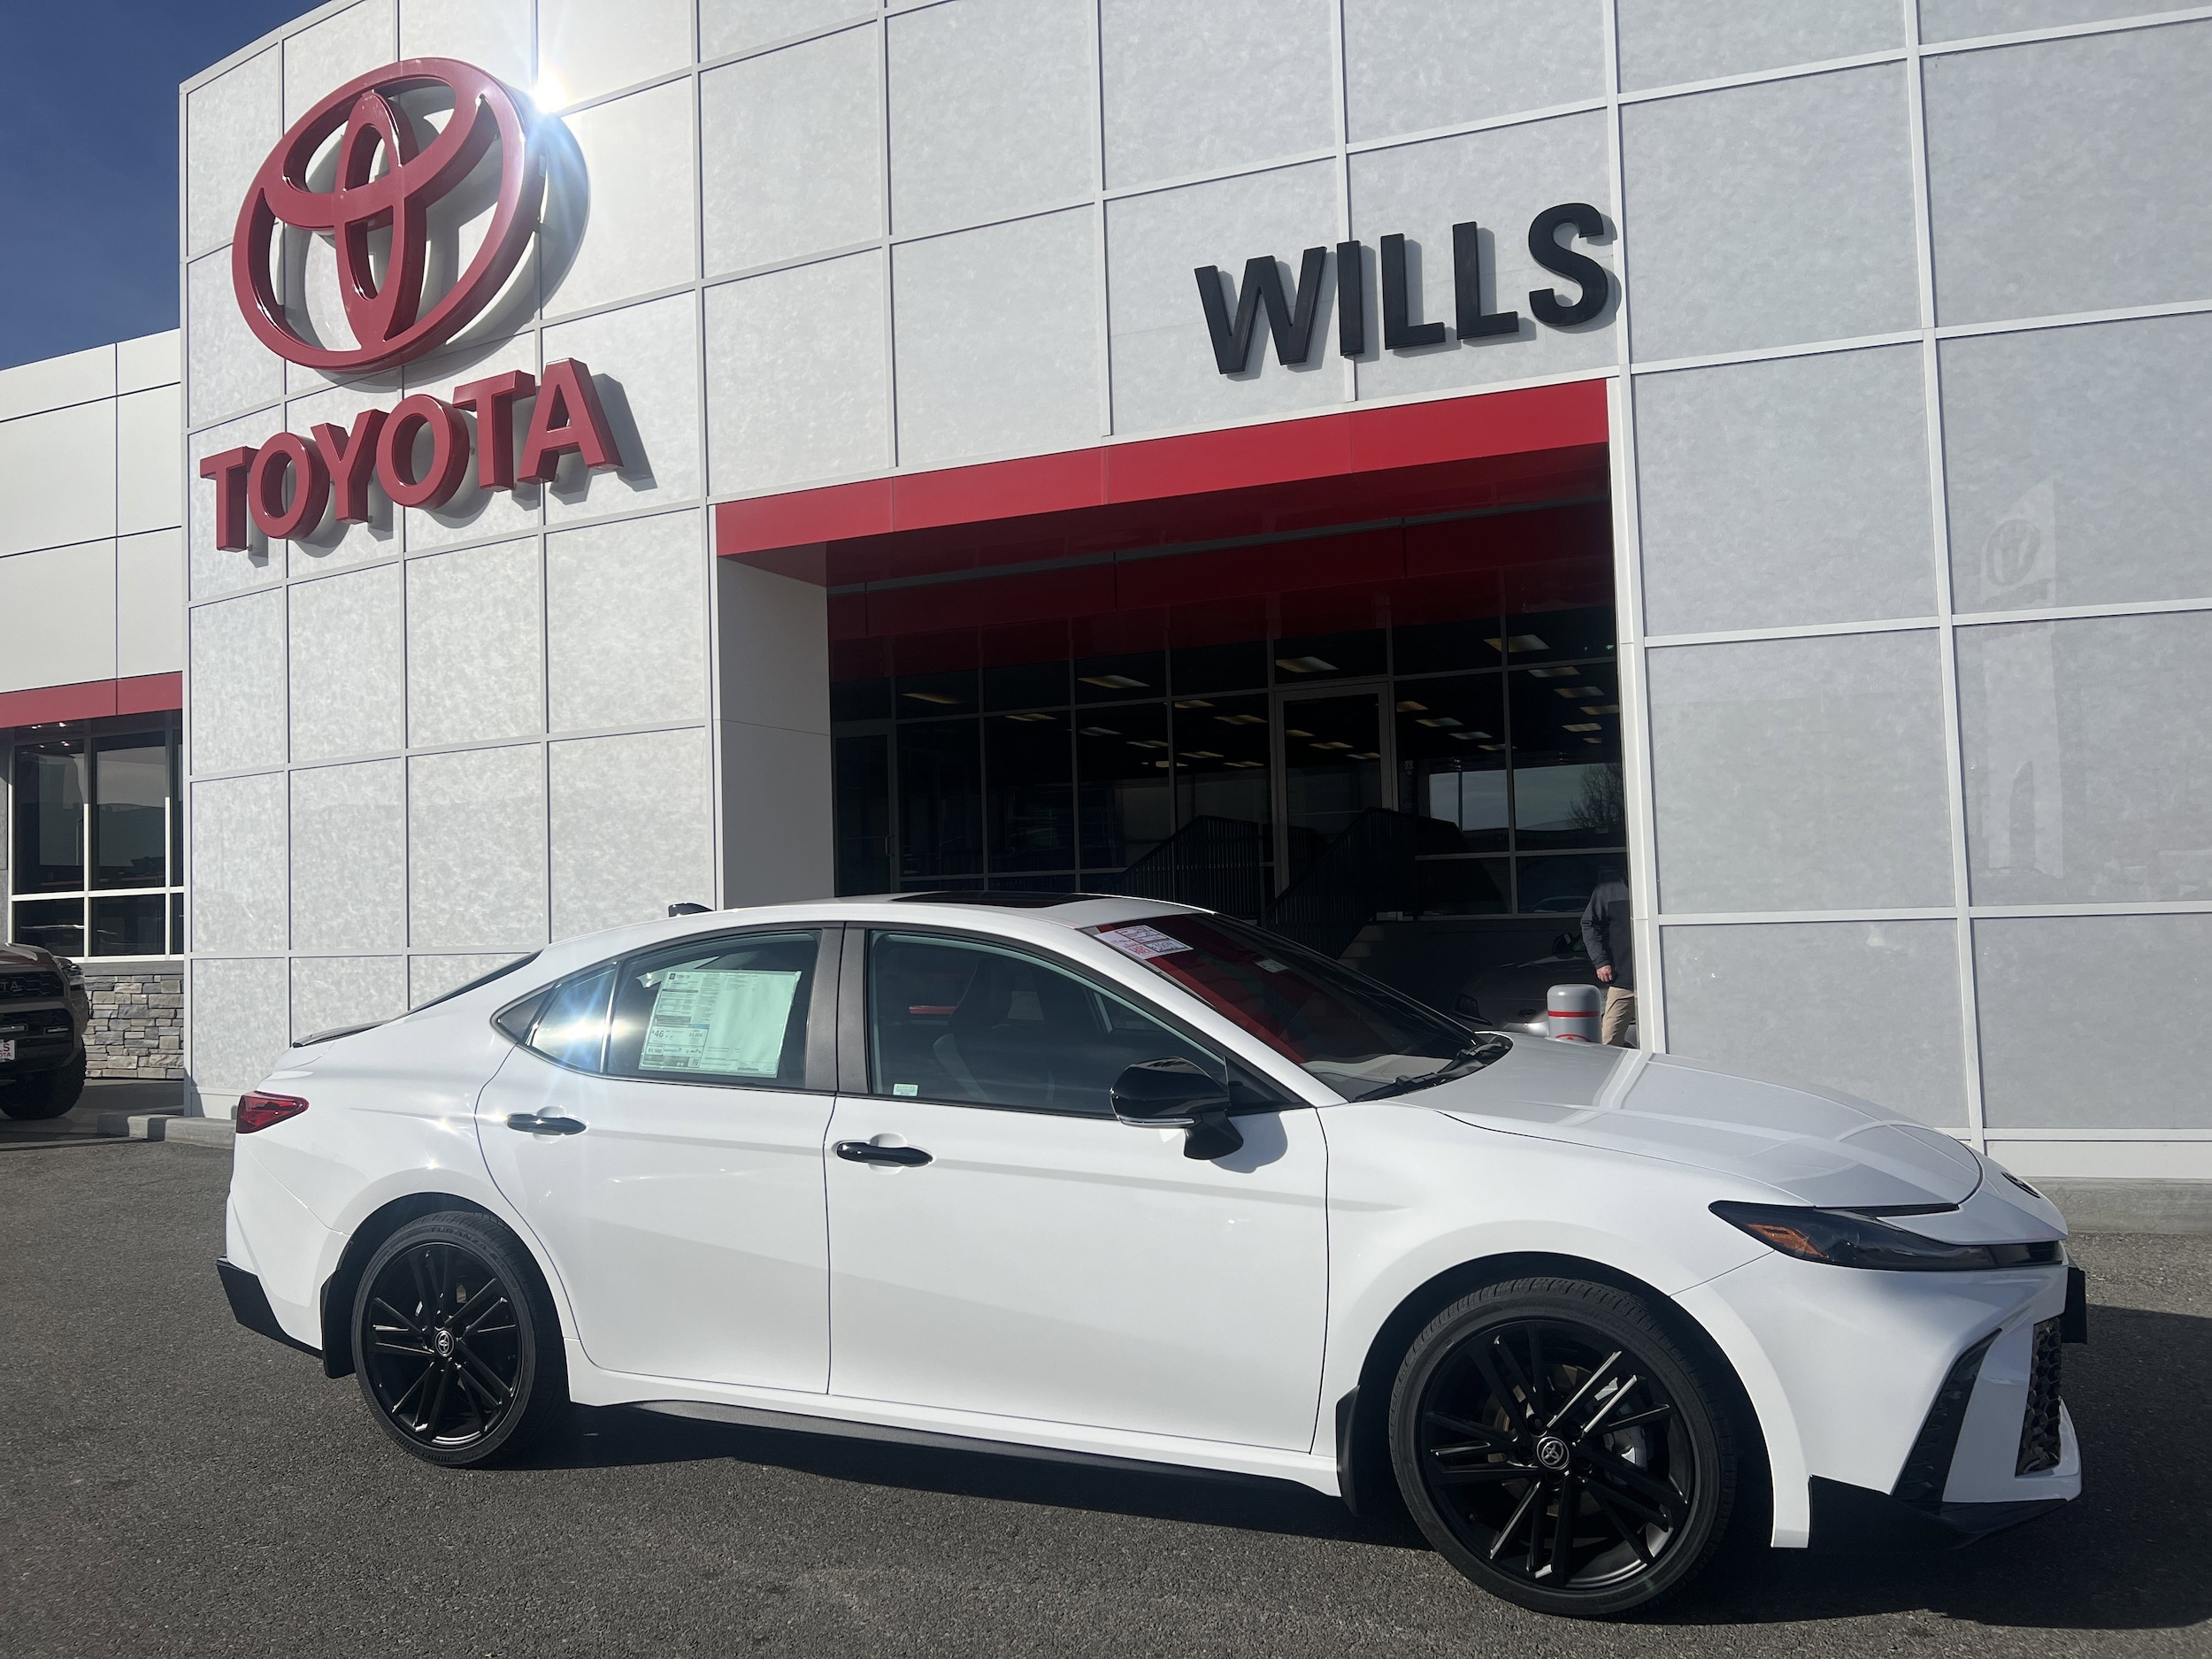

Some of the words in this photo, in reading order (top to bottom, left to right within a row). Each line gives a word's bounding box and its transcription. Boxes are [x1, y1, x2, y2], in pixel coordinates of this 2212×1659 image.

[1194, 203, 1609, 374] WILLS
[200, 357, 623, 553] TOYOTA
[431, 1226, 488, 1250] TURANZA
